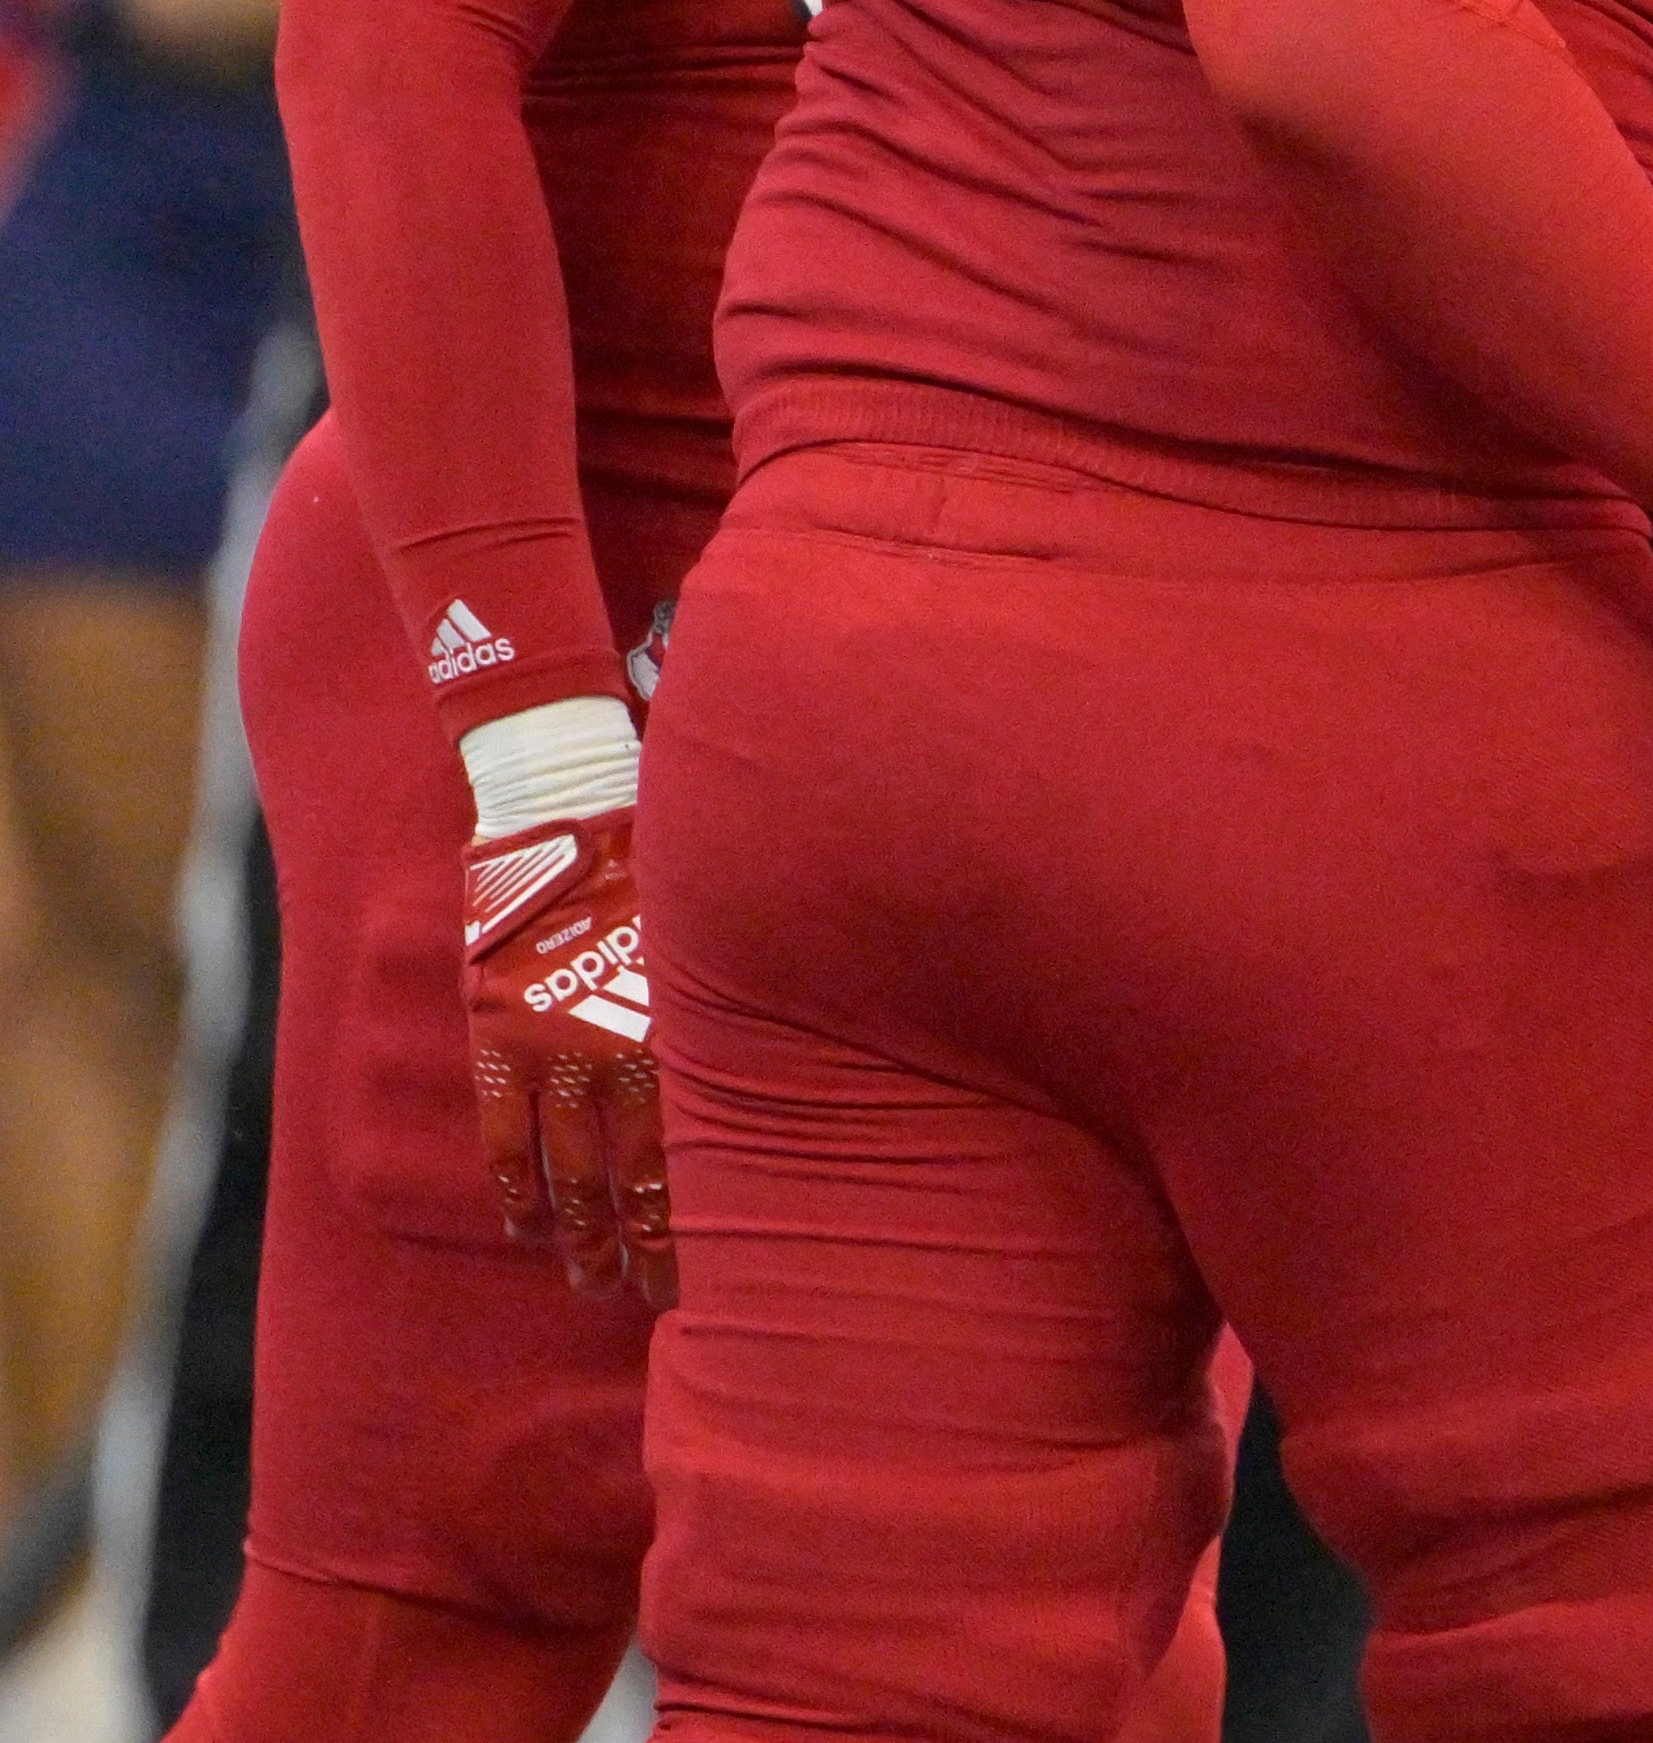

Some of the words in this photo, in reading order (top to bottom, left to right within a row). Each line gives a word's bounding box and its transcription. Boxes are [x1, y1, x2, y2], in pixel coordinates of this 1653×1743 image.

[427, 635, 515, 685] adidas
[535, 915, 592, 955] ADIZERO
[523, 914, 642, 1013] didas
